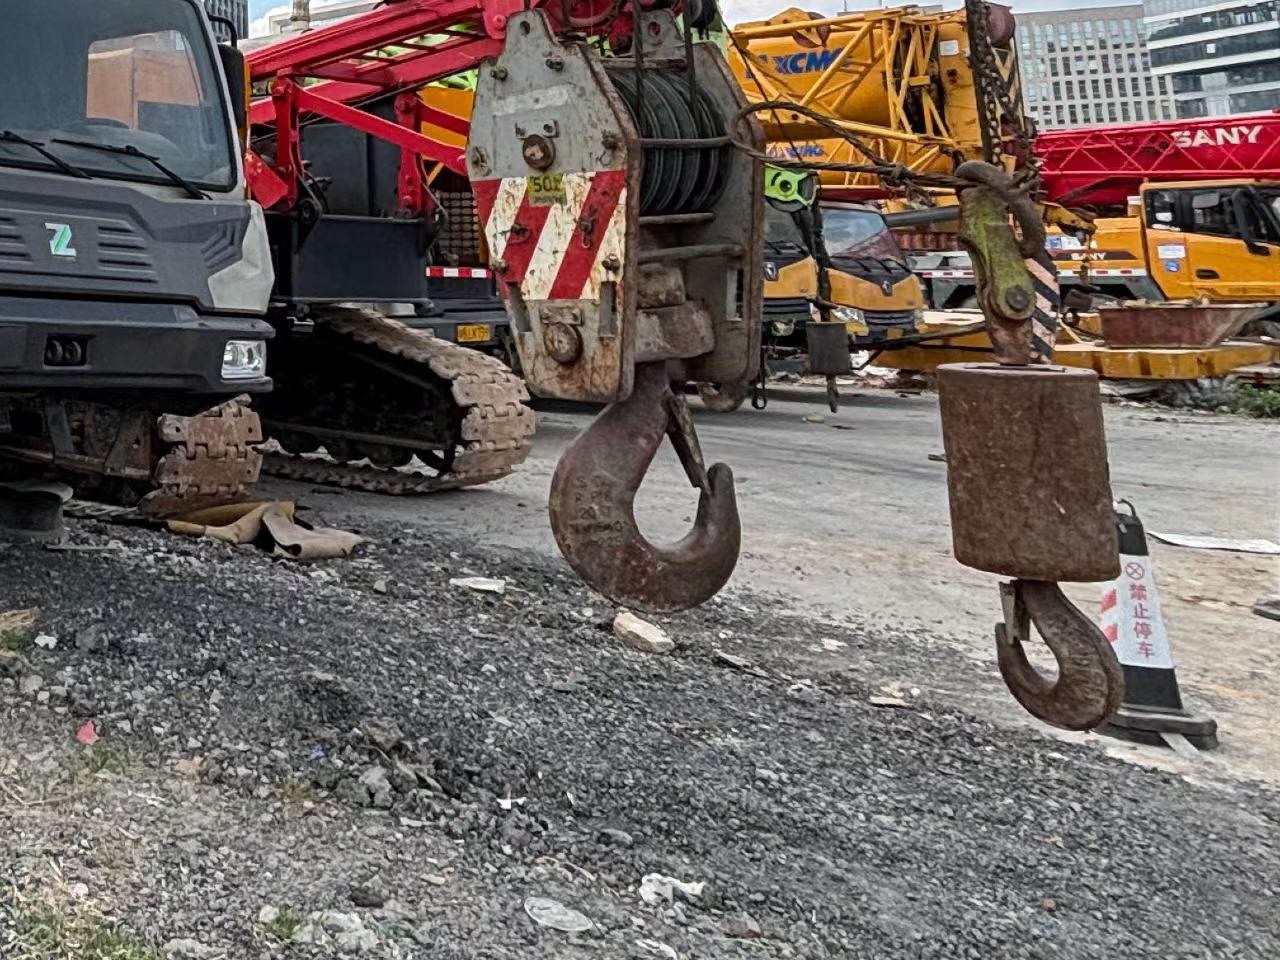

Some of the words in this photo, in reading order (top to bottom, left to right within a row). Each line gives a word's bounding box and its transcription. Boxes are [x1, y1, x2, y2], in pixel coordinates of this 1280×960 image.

[773, 48, 849, 74] XCM
[1171, 125, 1263, 148] SANY
[1129, 583, 1154, 659] 禁止停车
